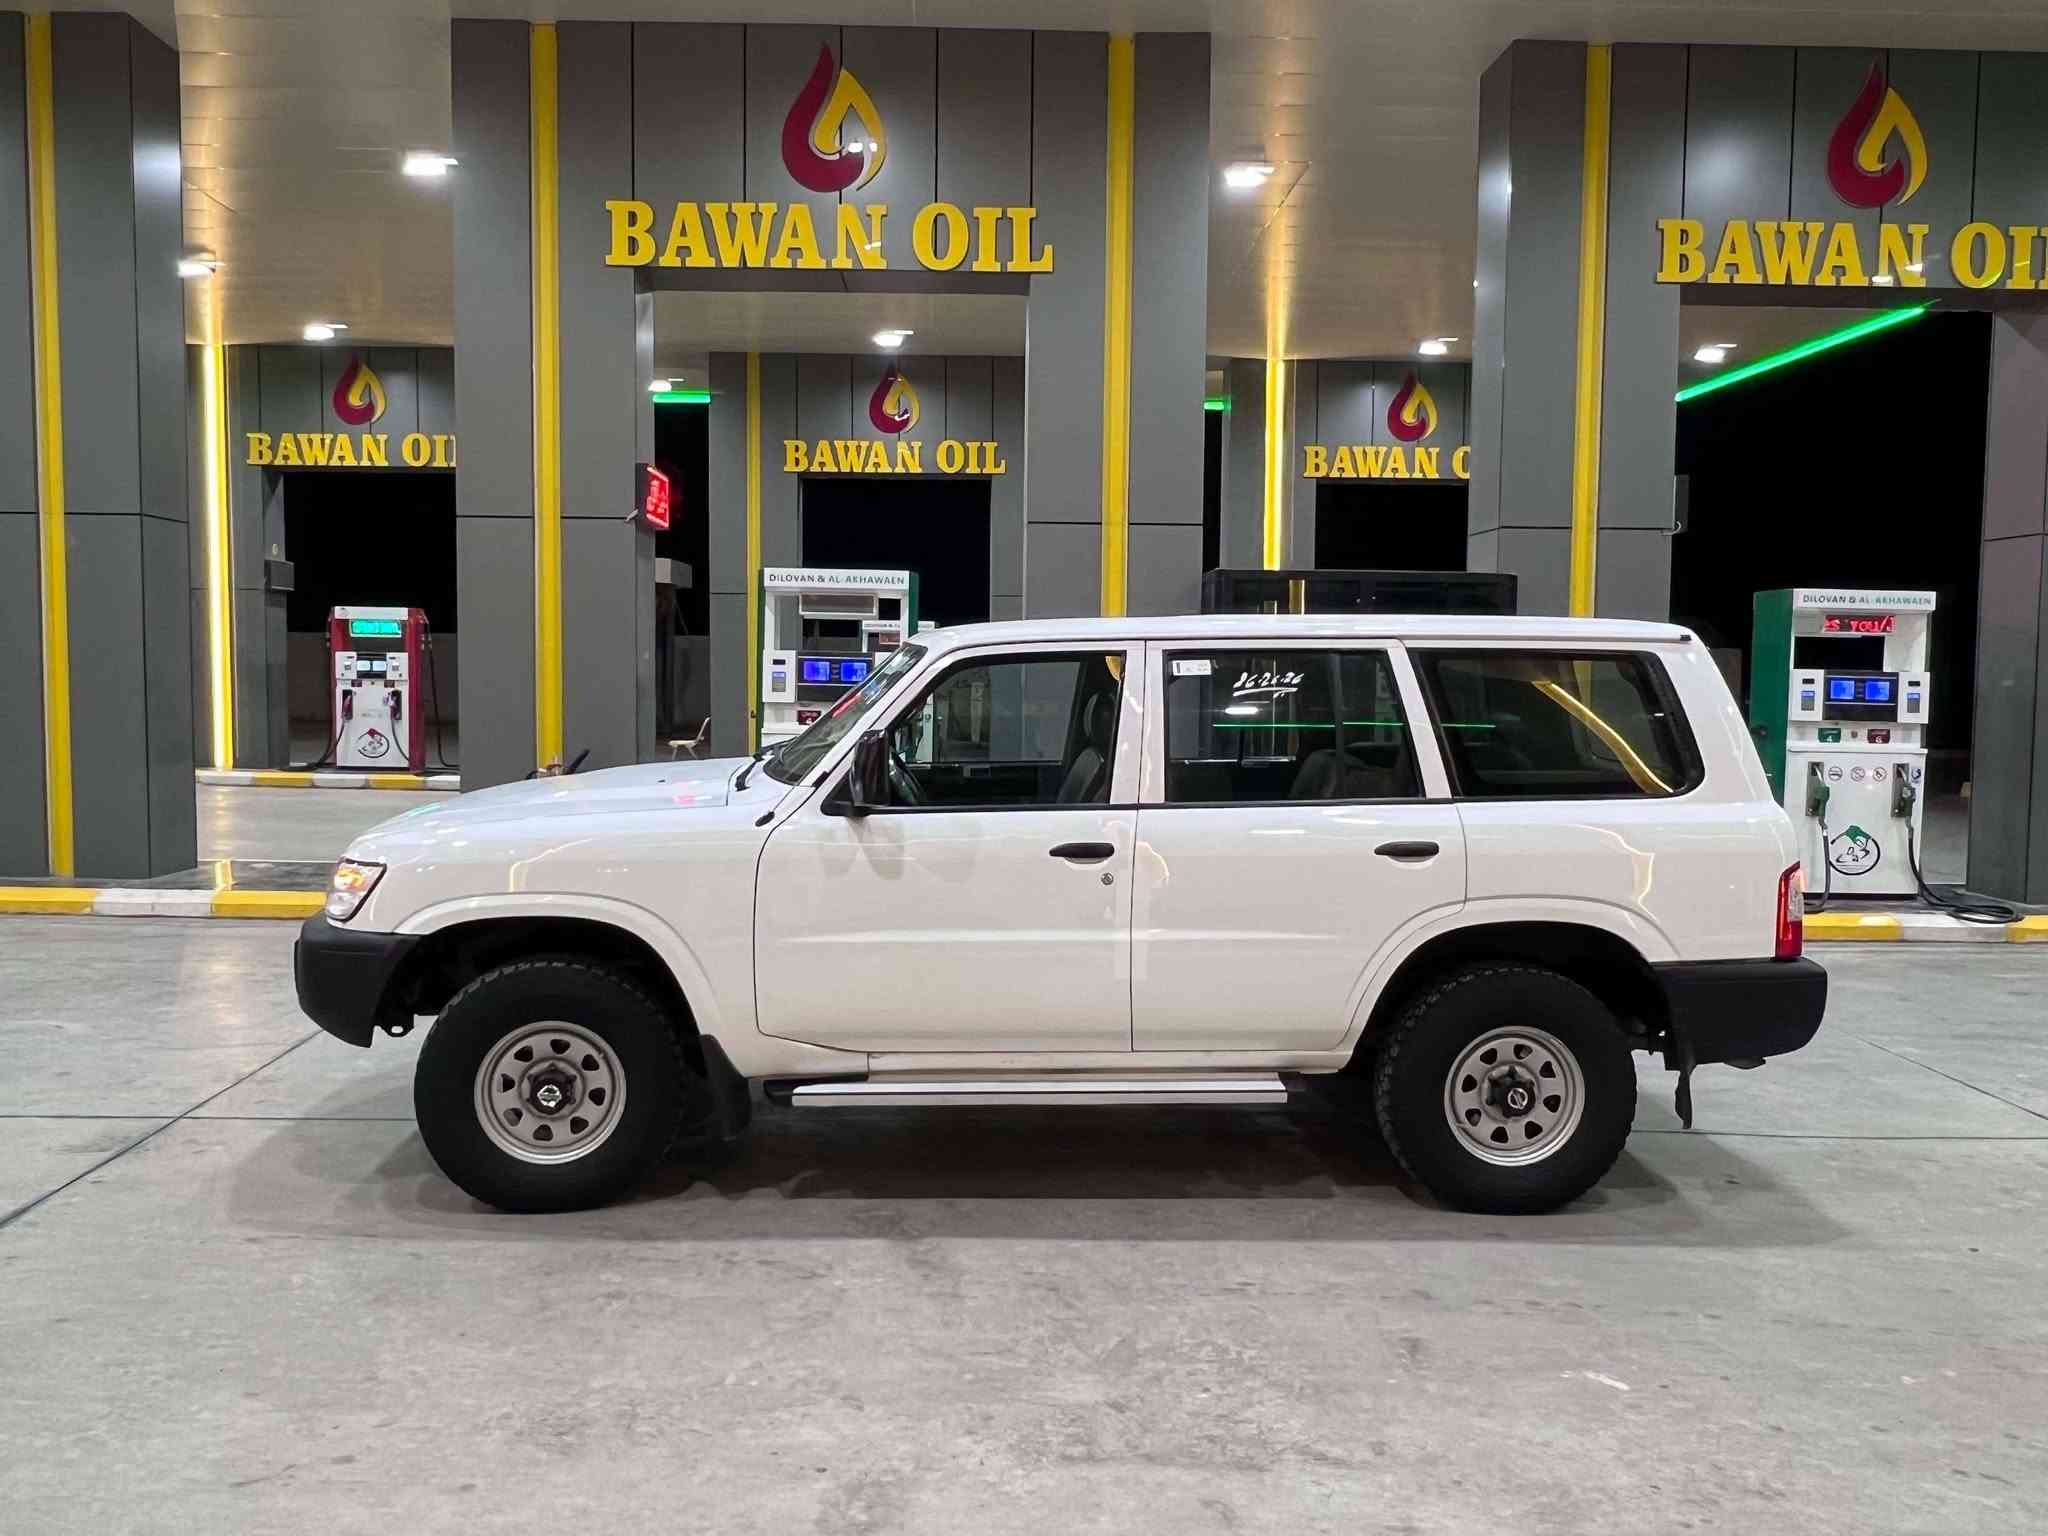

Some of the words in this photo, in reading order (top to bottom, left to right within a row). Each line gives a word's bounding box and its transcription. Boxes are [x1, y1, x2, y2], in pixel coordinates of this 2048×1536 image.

[604, 200, 889, 270] BAWAN
[912, 202, 1054, 273] OIL
[1656, 218, 1929, 288] BAWAN
[1950, 222, 2048, 290] OI
[246, 433, 389, 466] BAWAN
[402, 433, 456, 467] OI
[784, 440, 922, 473] BAWAN
[936, 440, 1006, 474] OIL
[1303, 445, 1440, 479] BAWAN
[769, 574, 816, 583] DILOVAN
[817, 575, 826, 583] &
[1802, 594, 1846, 604] DILOVAN
